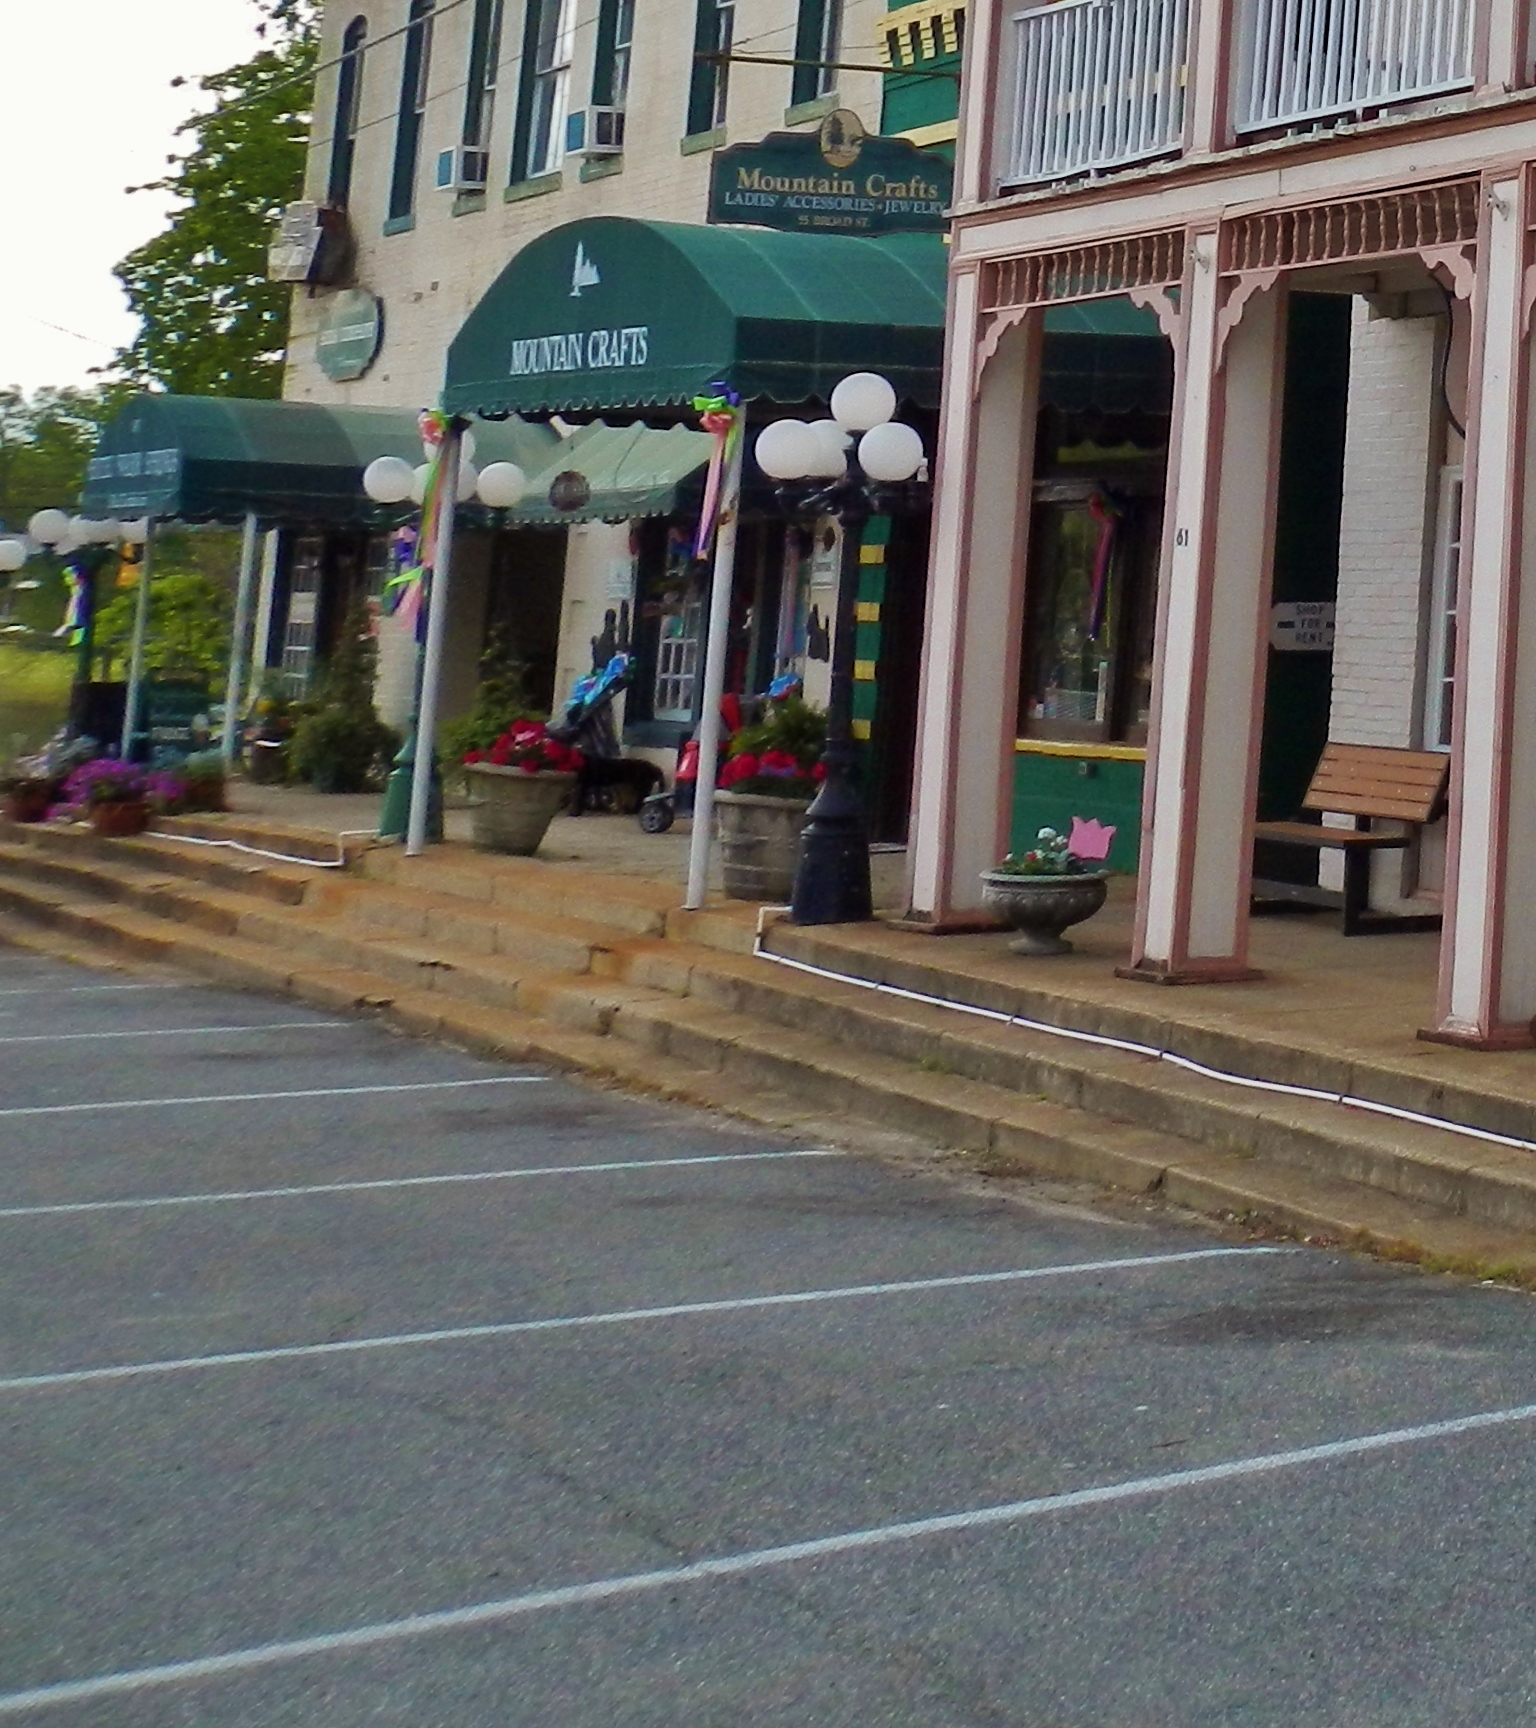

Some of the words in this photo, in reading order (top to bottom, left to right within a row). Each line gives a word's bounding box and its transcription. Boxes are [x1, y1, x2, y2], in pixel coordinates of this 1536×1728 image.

[737, 167, 855, 195] Mountain
[866, 174, 938, 199] Crafts
[783, 195, 875, 212] ACCESSORIES
[510, 332, 584, 375] MOUNTAIN
[588, 327, 649, 368] CRAFTS
[1176, 528, 1189, 547] 61
[1297, 604, 1324, 615] SHOP
[1301, 618, 1321, 629] FOR
